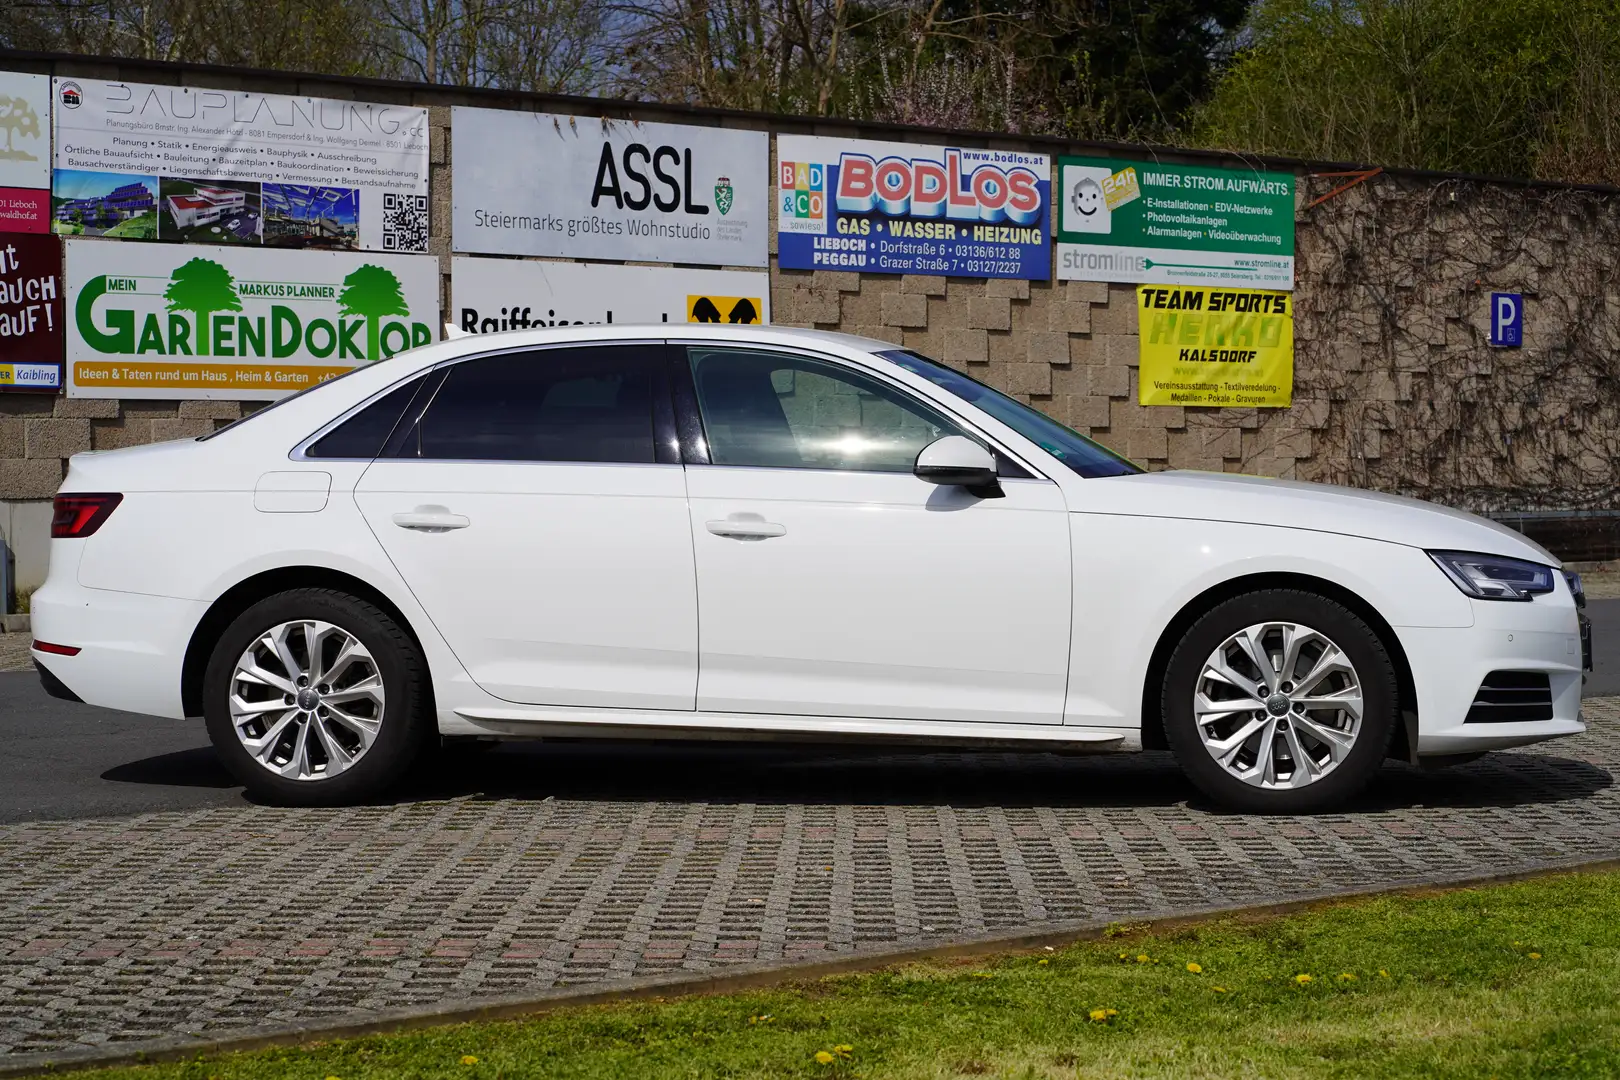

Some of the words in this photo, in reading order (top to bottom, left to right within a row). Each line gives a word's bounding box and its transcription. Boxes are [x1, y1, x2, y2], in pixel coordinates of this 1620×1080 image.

[106, 119, 153, 130] Planungsbüro
[177, 124, 189, 134] Ing.
[191, 125, 225, 135] Alexander
[267, 131, 305, 141] Empersdorf
[326, 136, 358, 146] Wolfgang
[64, 144, 101, 156] Örtliche
[103, 148, 154, 160] Bauaufsicht
[163, 153, 210, 165] Bauleitung
[218, 156, 268, 168] Bauzeitplan
[277, 160, 344, 172] Baukoordination
[353, 166, 419, 179] Beweissicherung
[112, 137, 148, 148] Planung
[157, 140, 182, 149] Statik
[192, 143, 257, 154] Energieausweis
[266, 147, 308, 159] Bauphysik
[317, 152, 377, 165] Ausschreibung
[963, 151, 1043, 165] www.bodlos.at
[68, 158, 159, 173] Bausachverständiger
[169, 165, 273, 181] Liegenschaftsbewertung
[282, 172, 332, 184] Vermessung
[341, 177, 416, 189] Bestandsaufnahme
[590, 141, 709, 215] ASSL
[783, 166, 822, 186] BAD
[1103, 170, 1137, 194] 24h
[9, 199, 38, 209] Lieboch
[1147, 198, 1208, 212] E-Installationen
[1215, 202, 1273, 215] EDV-Netzwerke
[475, 209, 563, 232] Steiermarks
[568, 216, 623, 237] größtes
[626, 219, 711, 240] Wohnstudio
[1147, 212, 1228, 227] Photovoltaikanlagen
[837, 218, 870, 235] GAS
[889, 220, 956, 240] WASSER
[974, 225, 1042, 245] HEIZUNG
[1147, 226, 1202, 240] Alarmanlagen
[1208, 229, 1282, 245] Videoüberwachung
[813, 237, 866, 252] LIEBOCH
[880, 240, 937, 256] Dorfstraße
[939, 245, 946, 256] 6
[955, 245, 1006, 259] 03136/612
[1009, 247, 1021, 260] 88
[813, 252, 866, 267] PEGGAU
[879, 256, 913, 269] Grazer
[915, 256, 950, 271] Straße
[952, 258, 958, 270] 7
[967, 260, 1021, 275] 03127/2237
[1063, 249, 1144, 272] stromline
[1234, 259, 1289, 269] www.stromline.at
[108, 279, 137, 291] MEIN
[239, 284, 285, 297] MARKUS
[287, 285, 335, 298] PLANNER
[1141, 288, 1204, 311] TEAM
[1207, 291, 1287, 314] SPORTS
[1498, 297, 1516, 341] P
[1179, 348, 1257, 363] KALSDORF
[16, 369, 56, 384] Kaibling
[79, 367, 109, 380] Ideen
[111, 368, 120, 380] &
[122, 369, 152, 380] Taten
[155, 369, 180, 381] rund
[182, 371, 199, 381] um
[235, 370, 262, 382] Heim
[264, 371, 272, 383] &
[274, 372, 308, 383] Garten
[1153, 380, 1219, 393] Vereinsausstattung
[1224, 382, 1277, 394] Textilveredelung
[1170, 392, 1203, 403] Medaillen
[1207, 393, 1231, 404] Pokale
[1236, 394, 1266, 404] Gravuren
